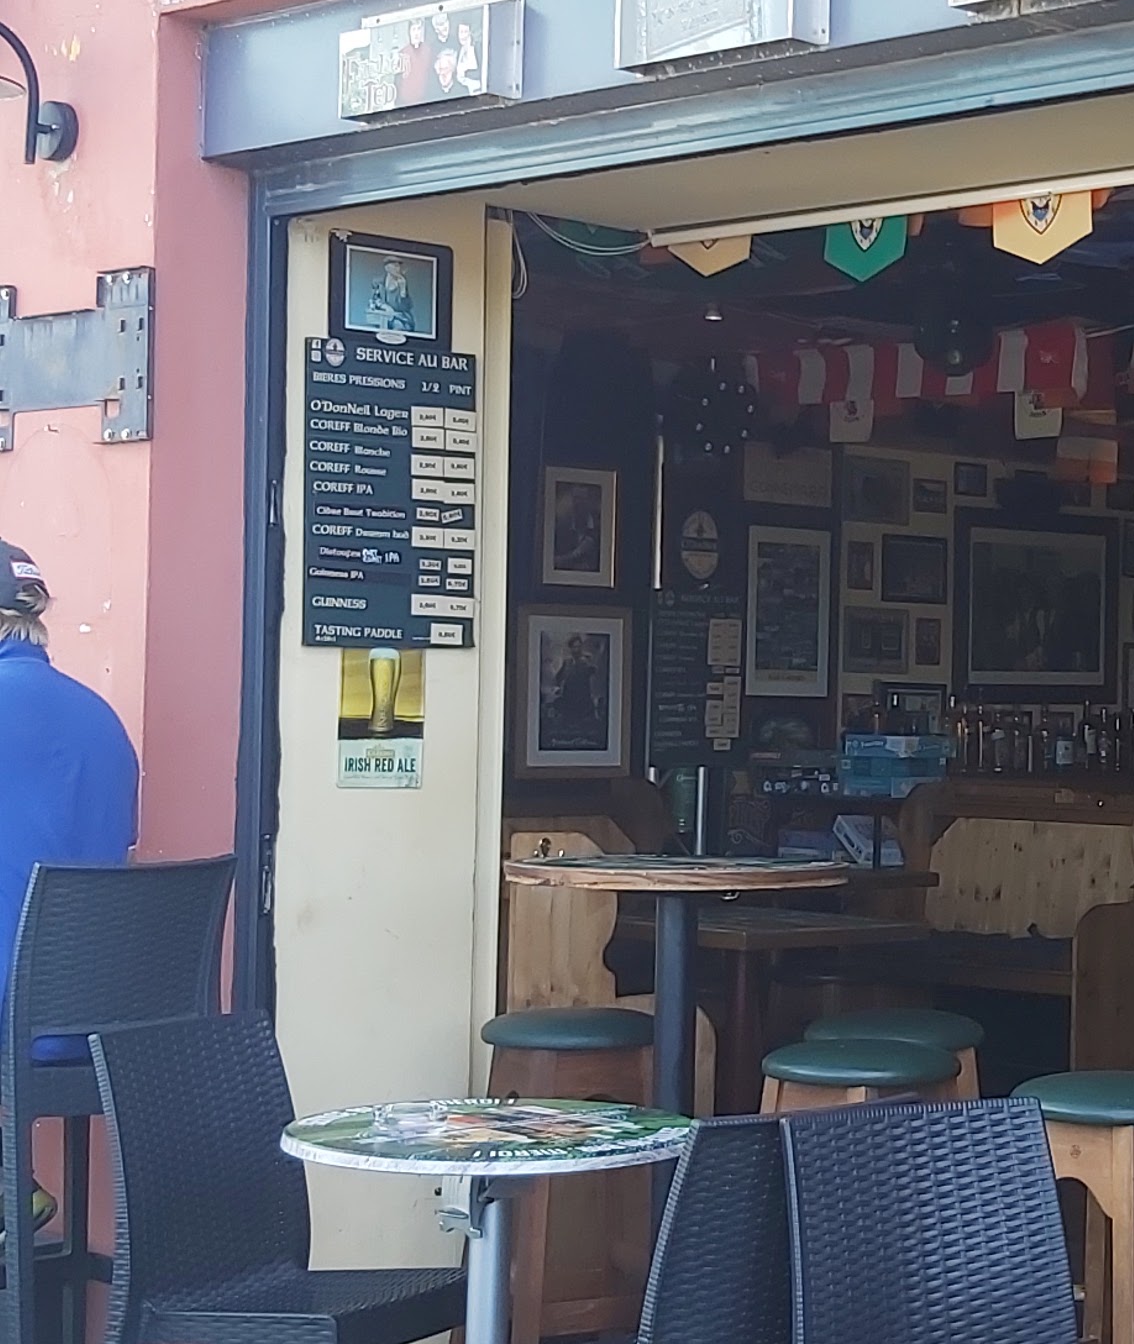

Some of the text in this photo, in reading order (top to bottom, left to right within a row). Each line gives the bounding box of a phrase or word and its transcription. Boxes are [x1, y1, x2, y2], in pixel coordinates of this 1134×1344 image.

[355, 347, 469, 372] SERVICE AU BAR
[421, 381, 441, 394] 1/2
[449, 384, 472, 396] PINT
[310, 418, 351, 431] COREFF
[309, 440, 350, 453] COREFF
[309, 460, 350, 474] COREFF
[313, 481, 374, 496] COREFF IPA
[311, 524, 353, 537] COREFF
[311, 596, 367, 610] GUINNESS
[314, 624, 403, 640] TASTING PADDLE
[344, 757, 416, 773] IRISH RED ALE
